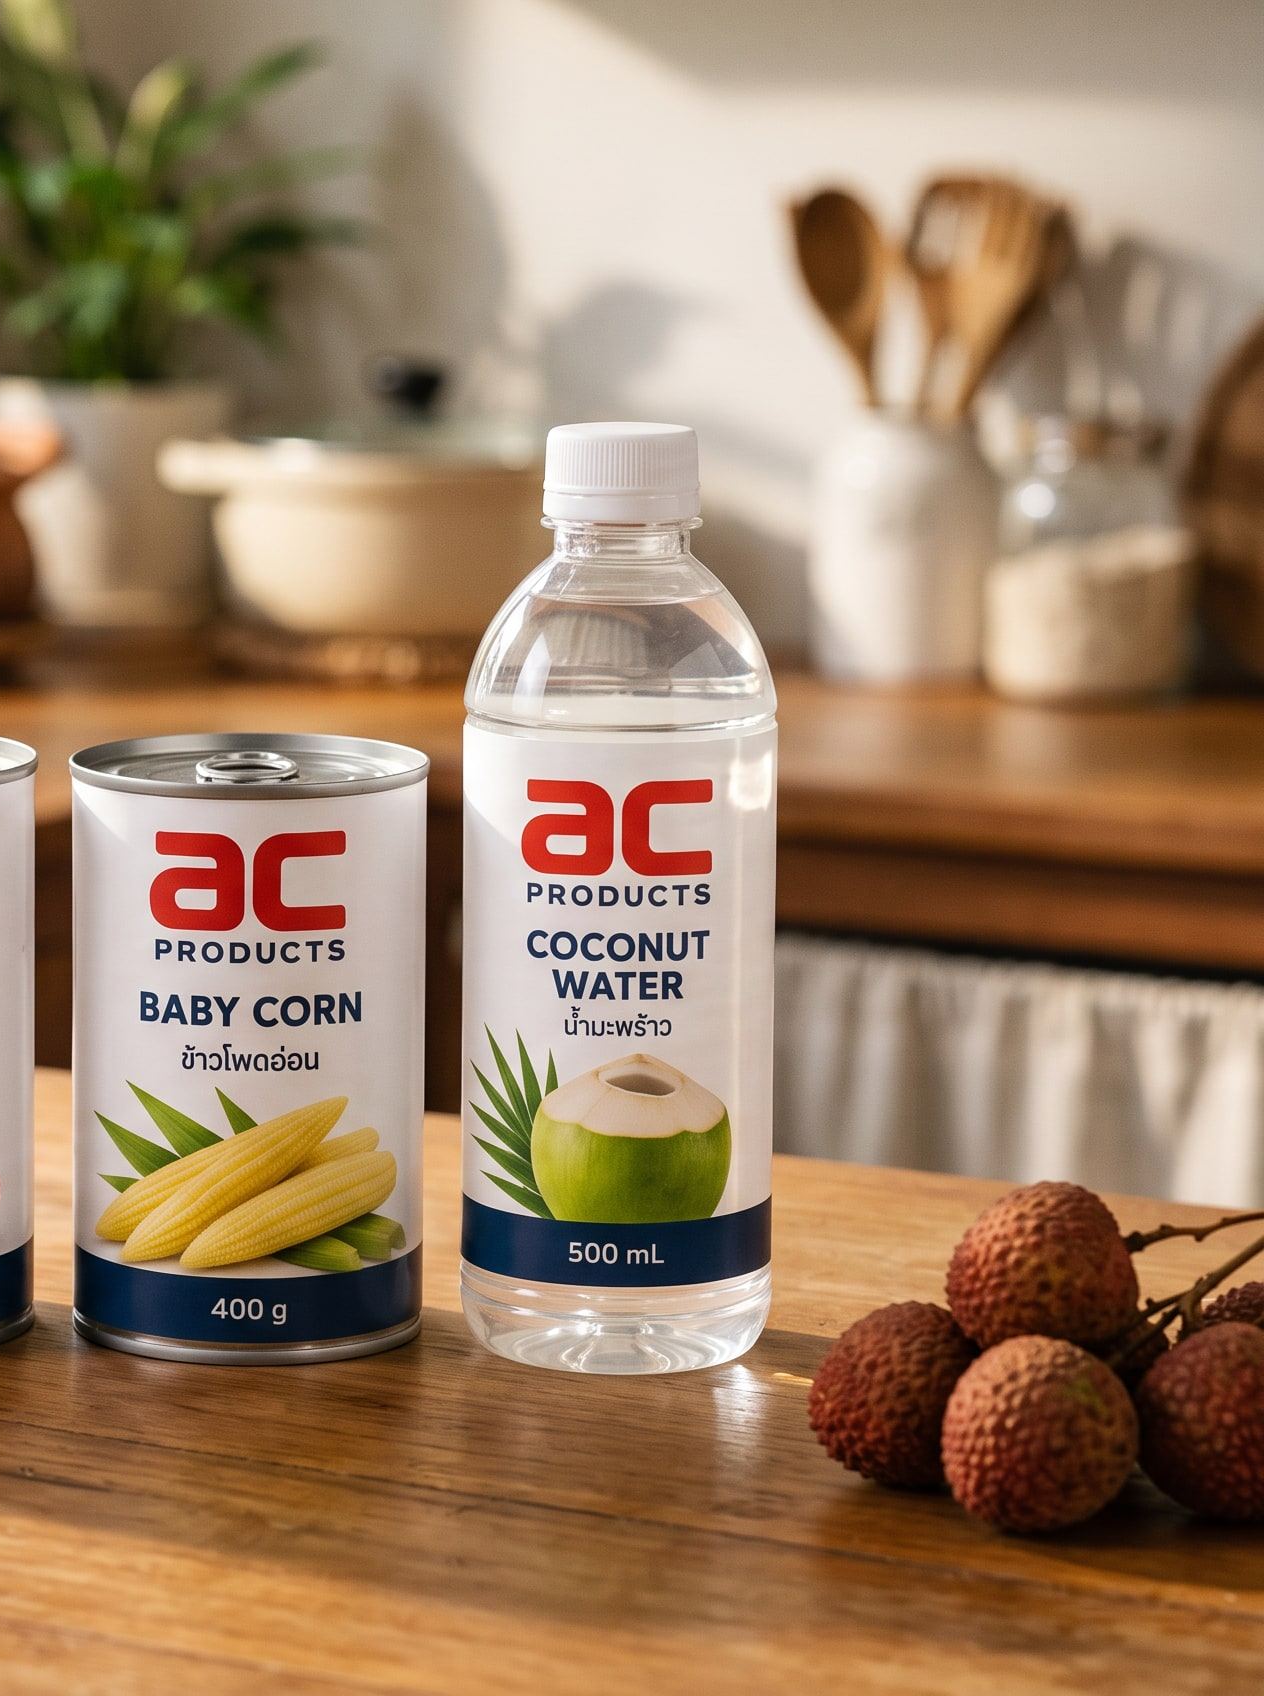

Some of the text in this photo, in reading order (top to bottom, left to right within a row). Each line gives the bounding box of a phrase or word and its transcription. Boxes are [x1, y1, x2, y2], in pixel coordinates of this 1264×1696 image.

[522, 779, 713, 876] ac
[150, 831, 346, 932] ac
[528, 883, 710, 907] PRODUCTS
[156, 939, 345, 964] PRODUCTS
[527, 930, 710, 962] COCONUT
[552, 969, 683, 1000] WATER
[141, 991, 361, 1027] BABY CORN
[565, 1006, 671, 1036] น้ำมะพร้าว
[182, 1044, 318, 1071] ข้าวโพดอ่อน
[569, 1242, 664, 1264] 500 mL
[211, 1298, 286, 1325] 400 g
